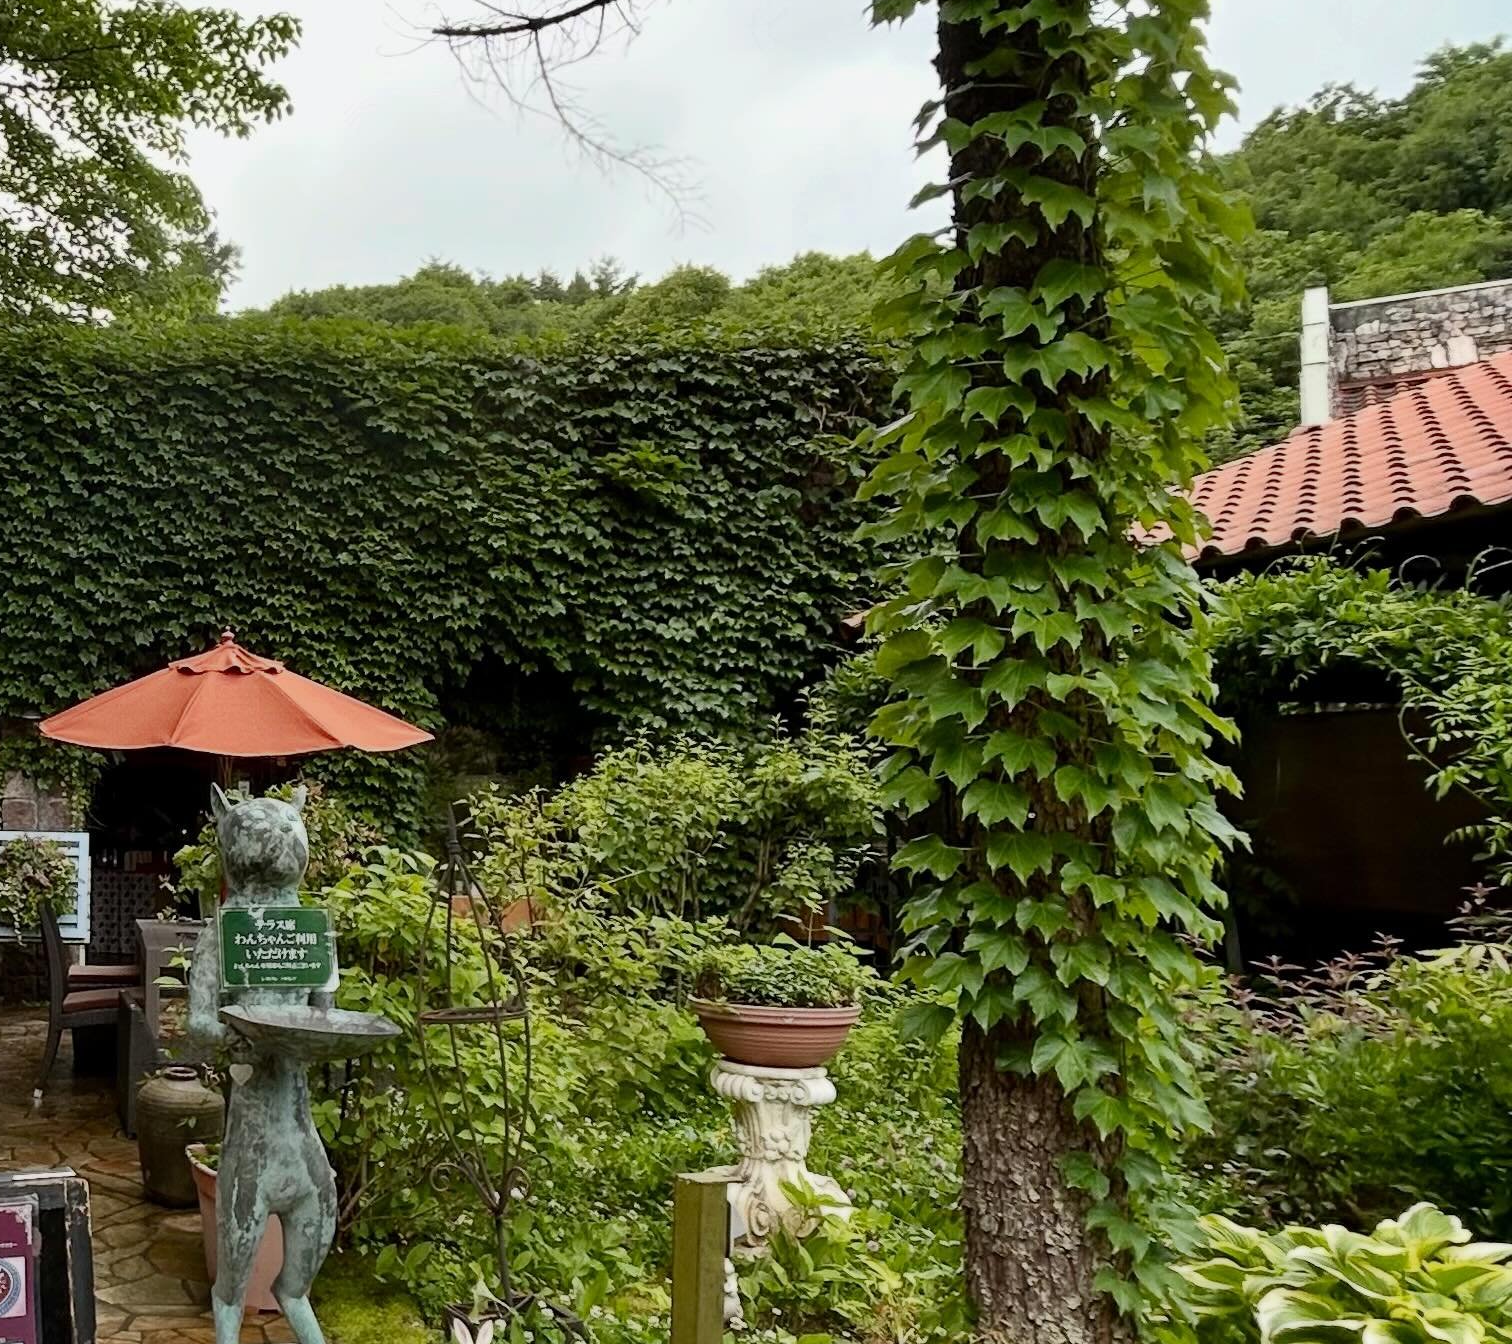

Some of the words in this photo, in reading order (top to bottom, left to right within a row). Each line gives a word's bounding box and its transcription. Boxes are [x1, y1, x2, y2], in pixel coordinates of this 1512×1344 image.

[234, 933, 317, 945] わんちゃんご利用
[245, 947, 308, 960] いただけます
